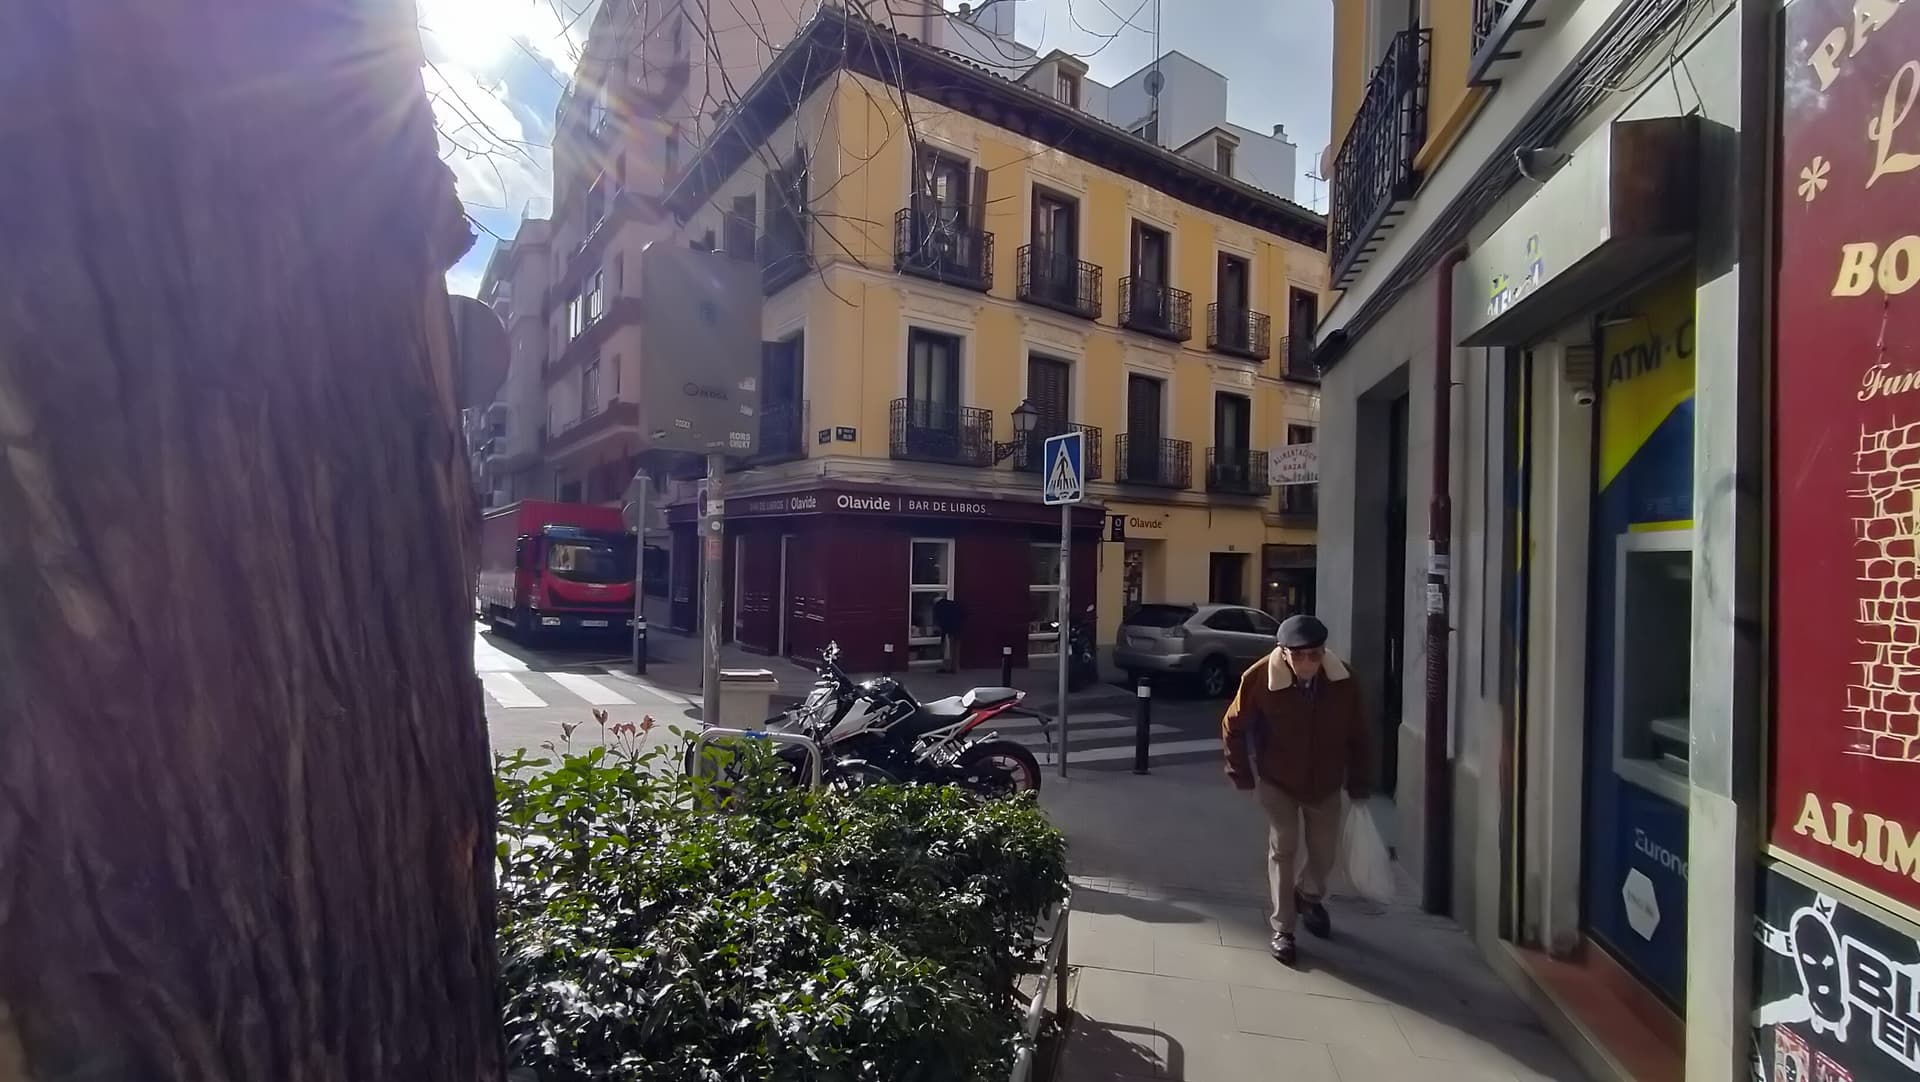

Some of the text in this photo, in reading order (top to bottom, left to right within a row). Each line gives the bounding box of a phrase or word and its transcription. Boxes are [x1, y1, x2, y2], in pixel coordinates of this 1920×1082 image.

[1831, 235, 1920, 297] BO
[791, 496, 817, 510] Olavide
[837, 495, 987, 513] Olavide BAR DE LIBROS
[1129, 517, 1162, 529] Olavide
[1793, 792, 1920, 883] ALIM
